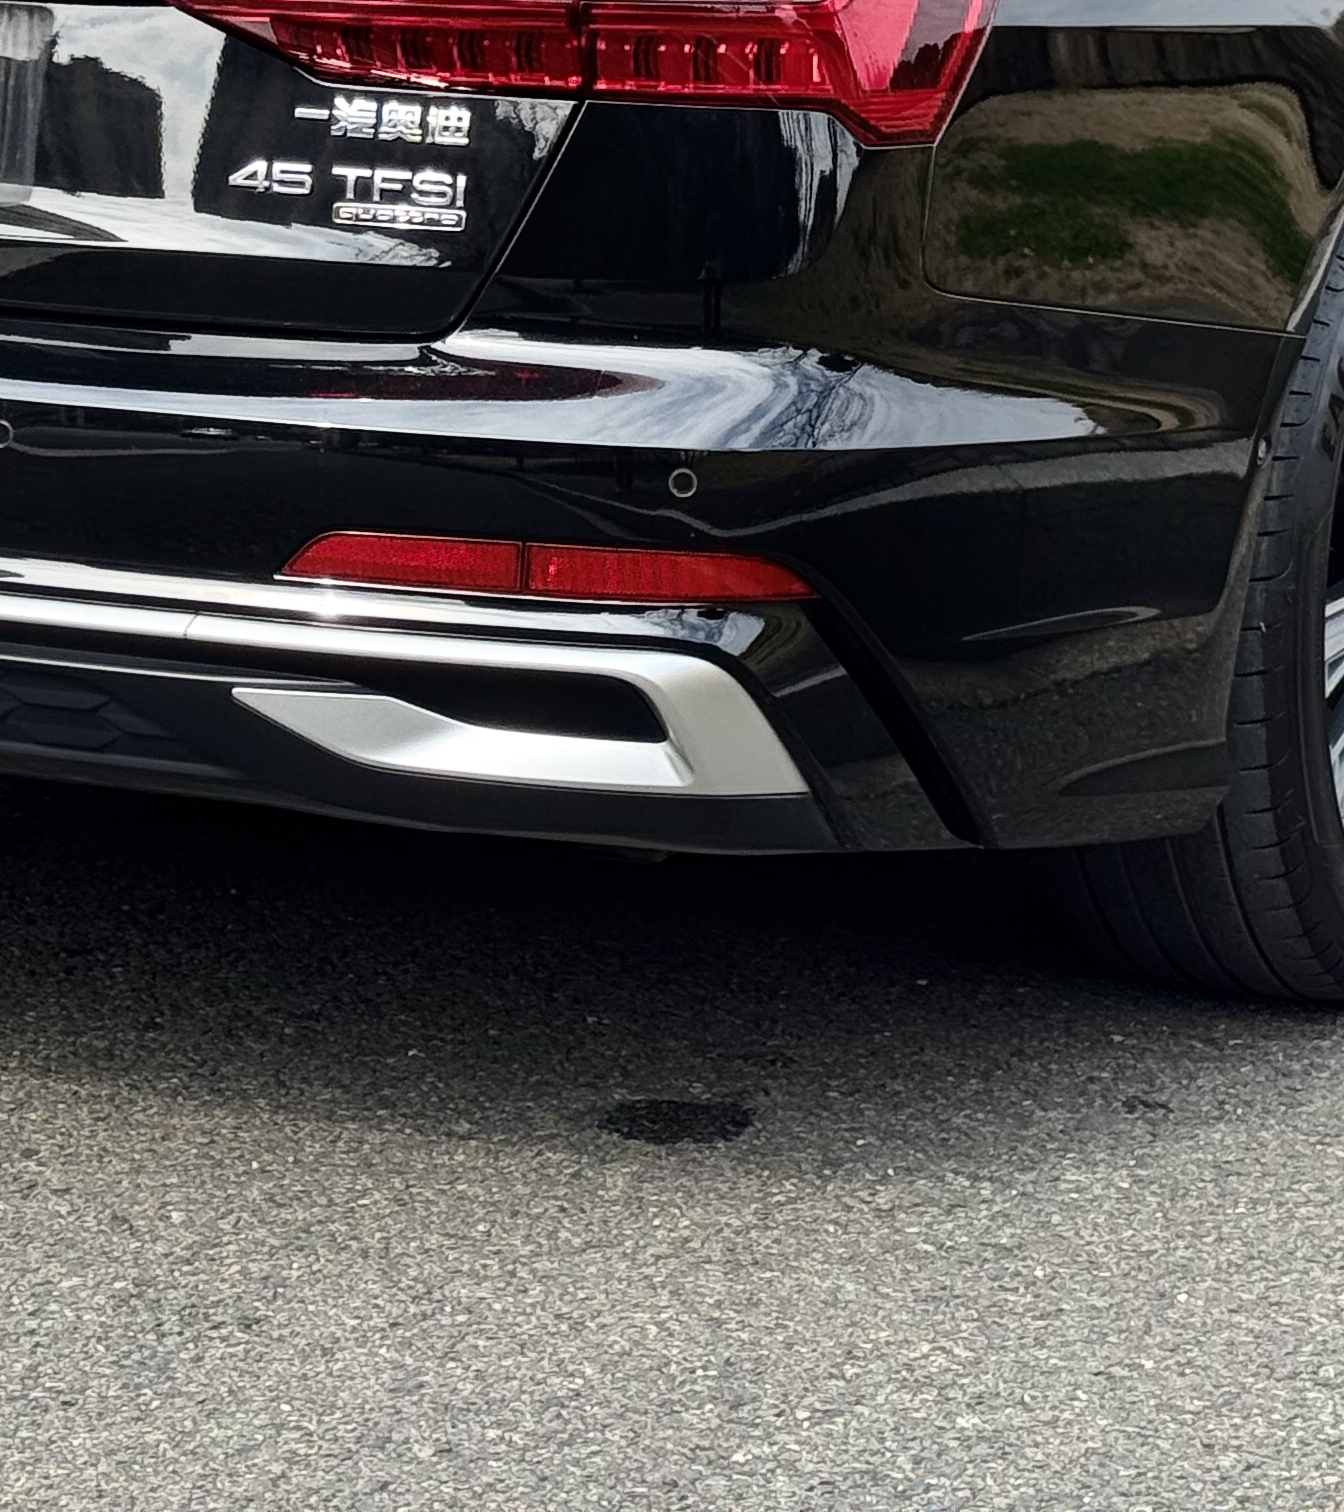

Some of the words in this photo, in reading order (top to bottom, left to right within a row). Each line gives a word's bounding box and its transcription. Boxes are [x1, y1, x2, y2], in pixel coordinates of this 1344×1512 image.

[294, 96, 471, 146] 一汽奥迪
[228, 160, 313, 194] 45
[331, 165, 468, 208] TFSI
